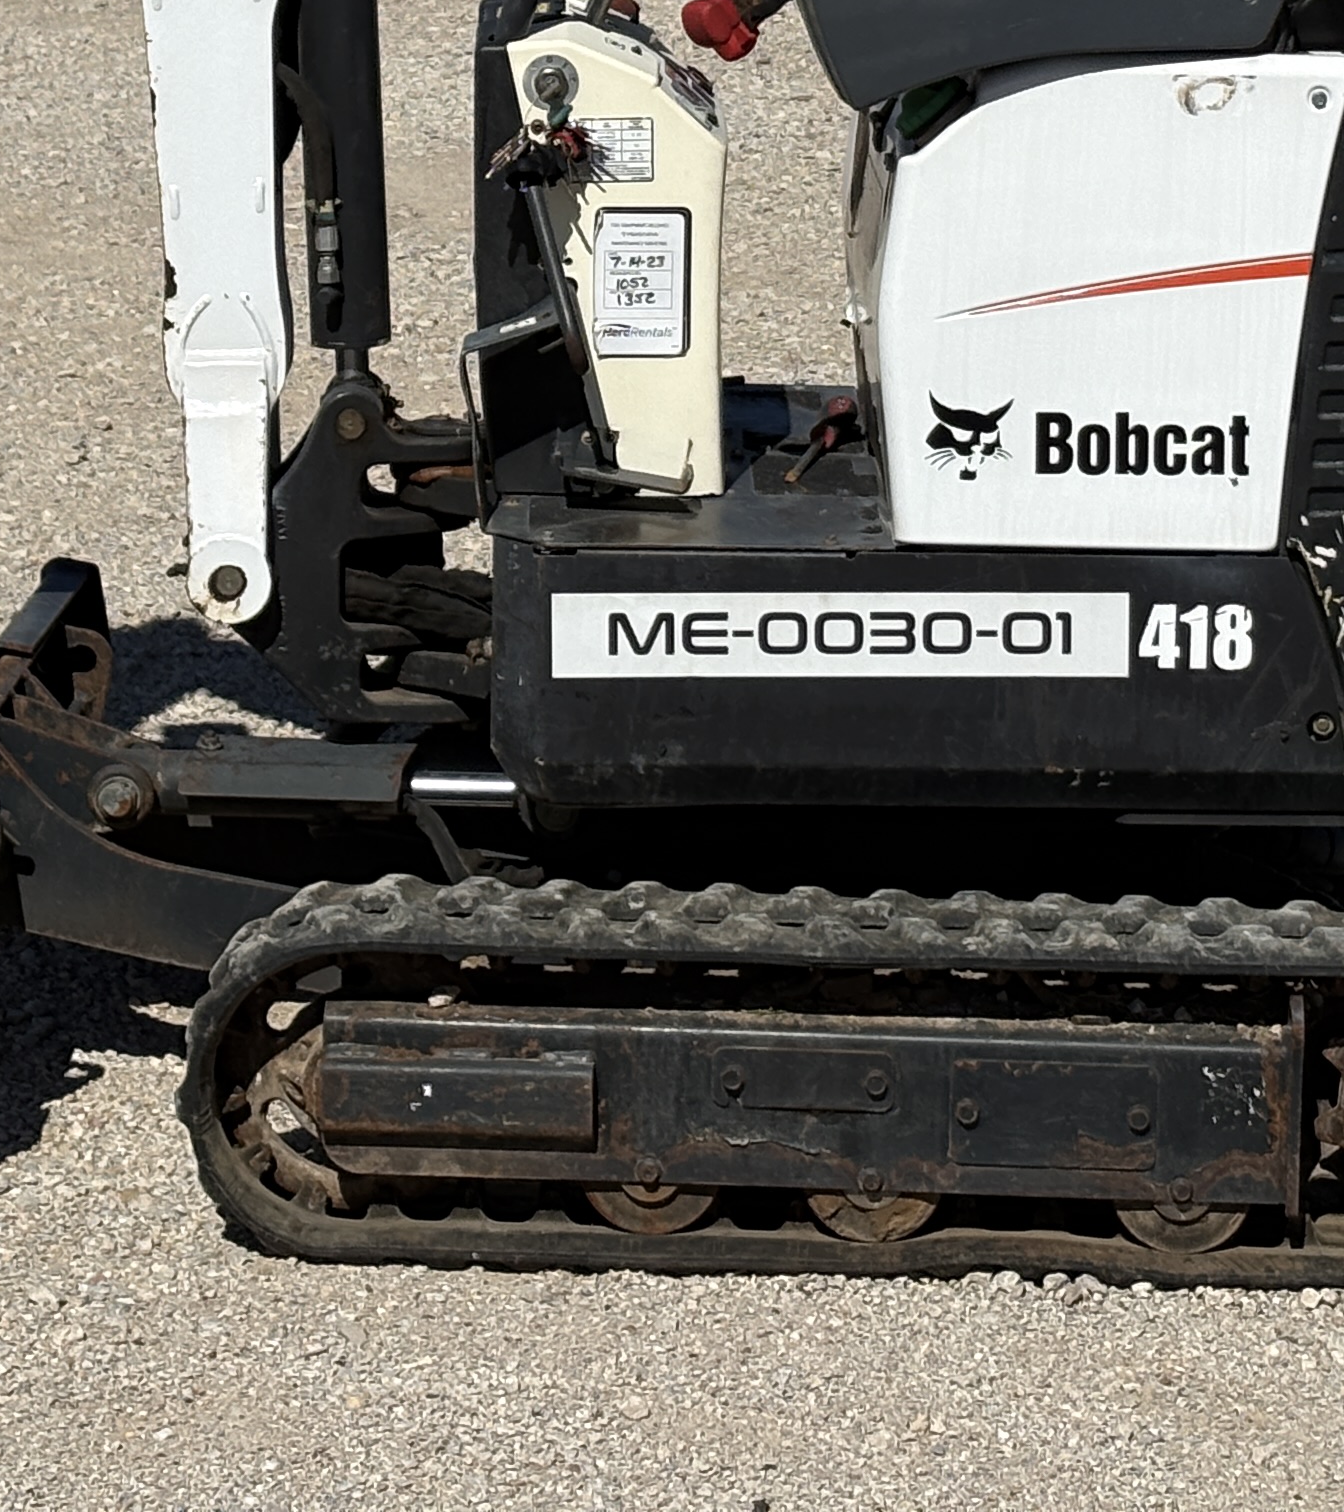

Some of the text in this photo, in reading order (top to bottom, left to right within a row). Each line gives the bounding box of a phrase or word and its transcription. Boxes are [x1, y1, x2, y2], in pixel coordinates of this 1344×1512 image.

[1035, 411, 1250, 476] Bobcat
[607, 610, 1074, 656] ME-0030-01
[1138, 603, 1254, 670] 418
